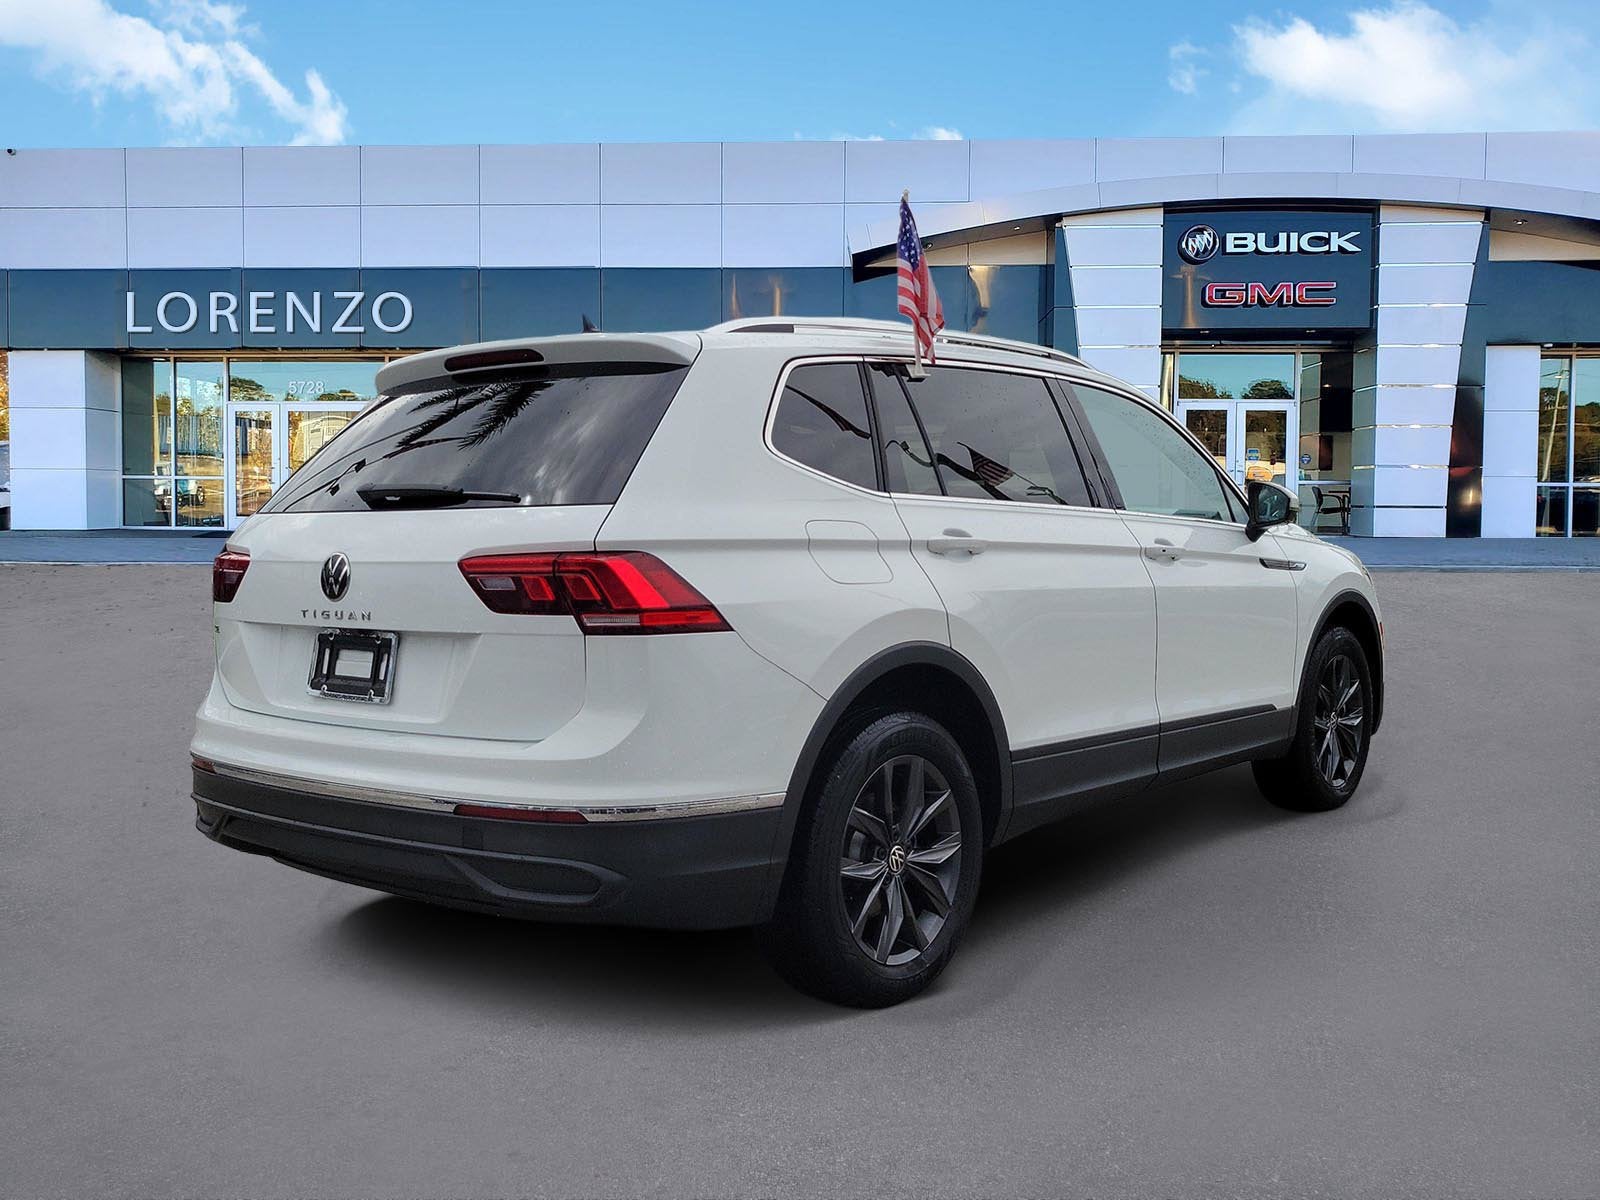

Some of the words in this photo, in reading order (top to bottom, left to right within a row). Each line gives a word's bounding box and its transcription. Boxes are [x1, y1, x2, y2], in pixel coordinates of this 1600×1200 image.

[1226, 231, 1362, 253] BUICK
[1205, 281, 1337, 305] GMC
[126, 291, 413, 333] LORENZO
[288, 381, 325, 394] 5728
[301, 608, 371, 621] TIGUAN
